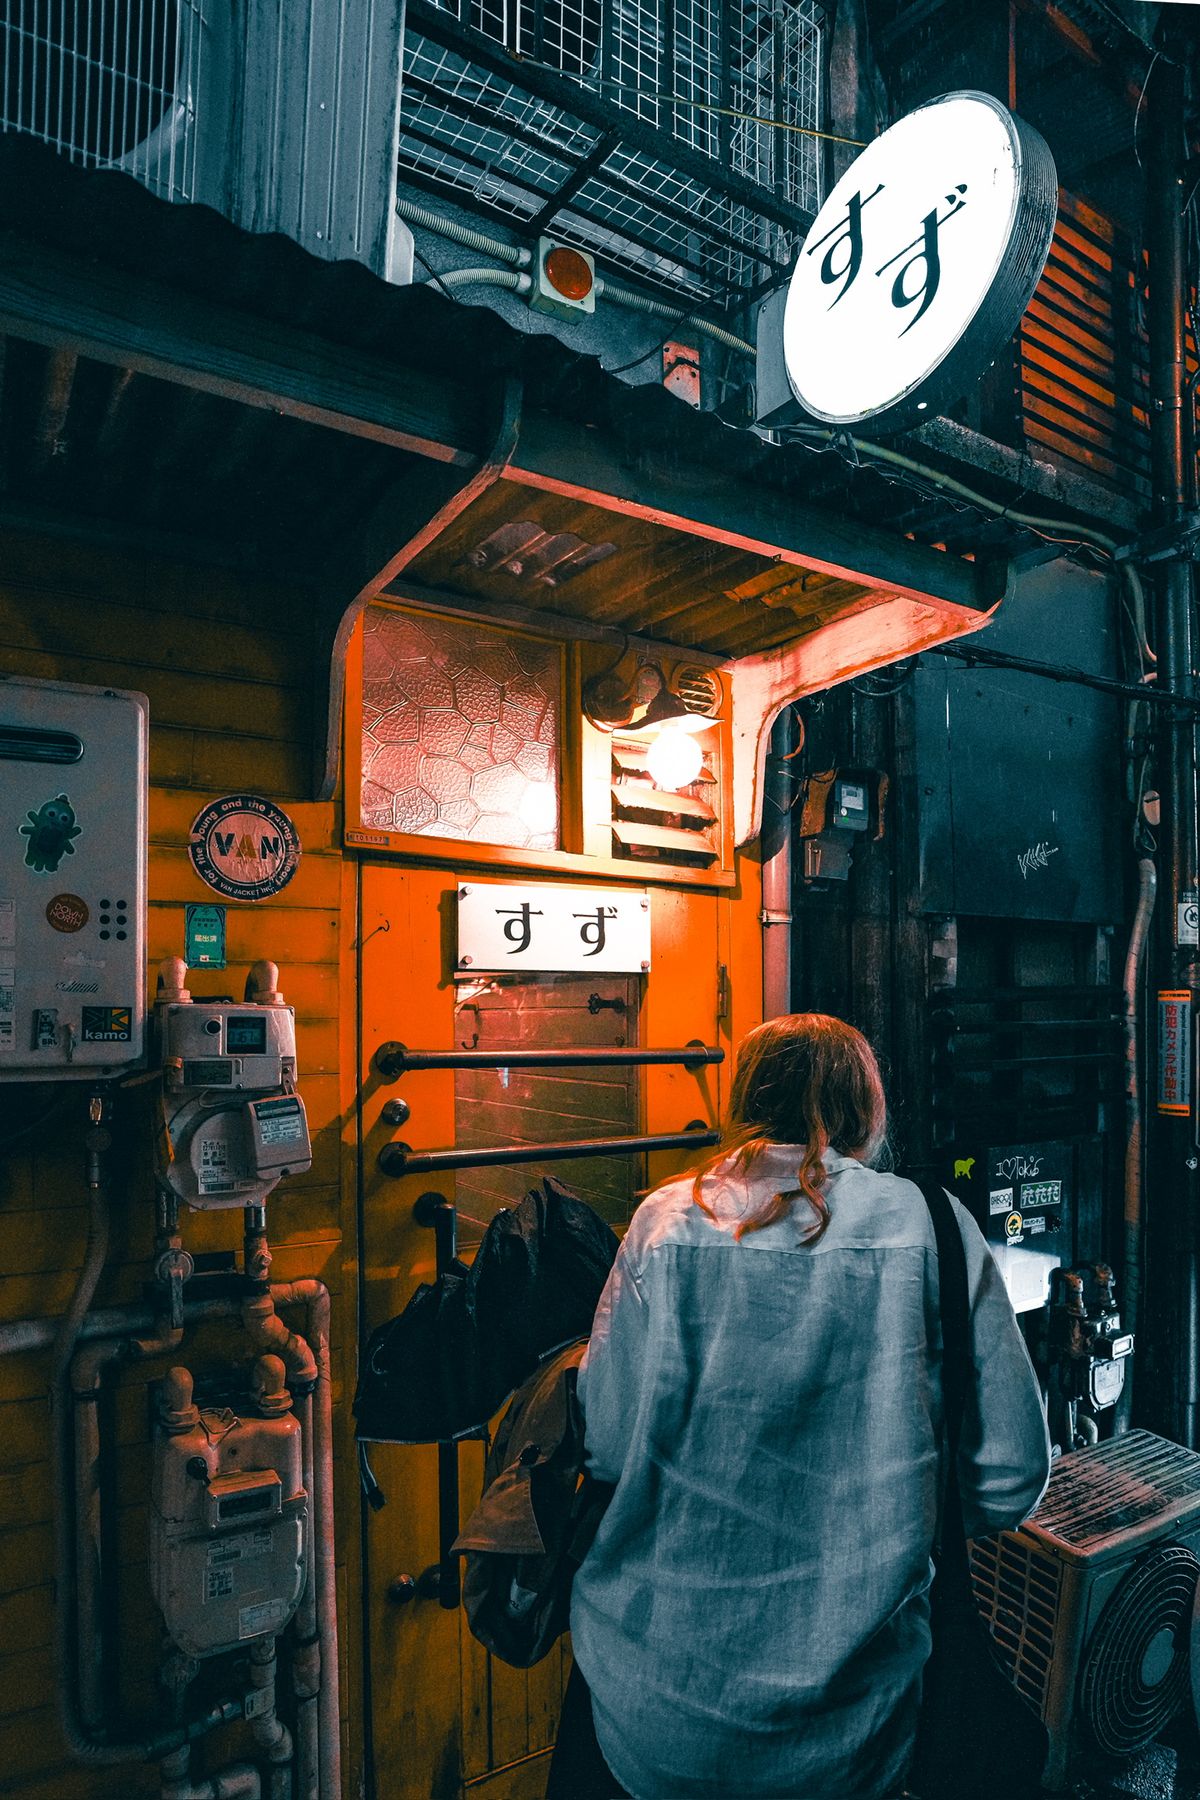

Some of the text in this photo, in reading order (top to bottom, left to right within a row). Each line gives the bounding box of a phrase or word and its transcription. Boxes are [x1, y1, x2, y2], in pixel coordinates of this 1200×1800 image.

[806, 183, 968, 339] すず
[221, 799, 242, 811] and
[248, 800, 266, 812] the
[214, 831, 280, 861] VAN
[195, 846, 207, 865] the
[204, 869, 219, 884] for
[220, 882, 232, 893] VAN
[233, 889, 260, 897] JACKET
[494, 902, 618, 957] すず
[85, 1030, 128, 1040] kamo
[1164, 1004, 1178, 1102] 防犯カメラ作動中
